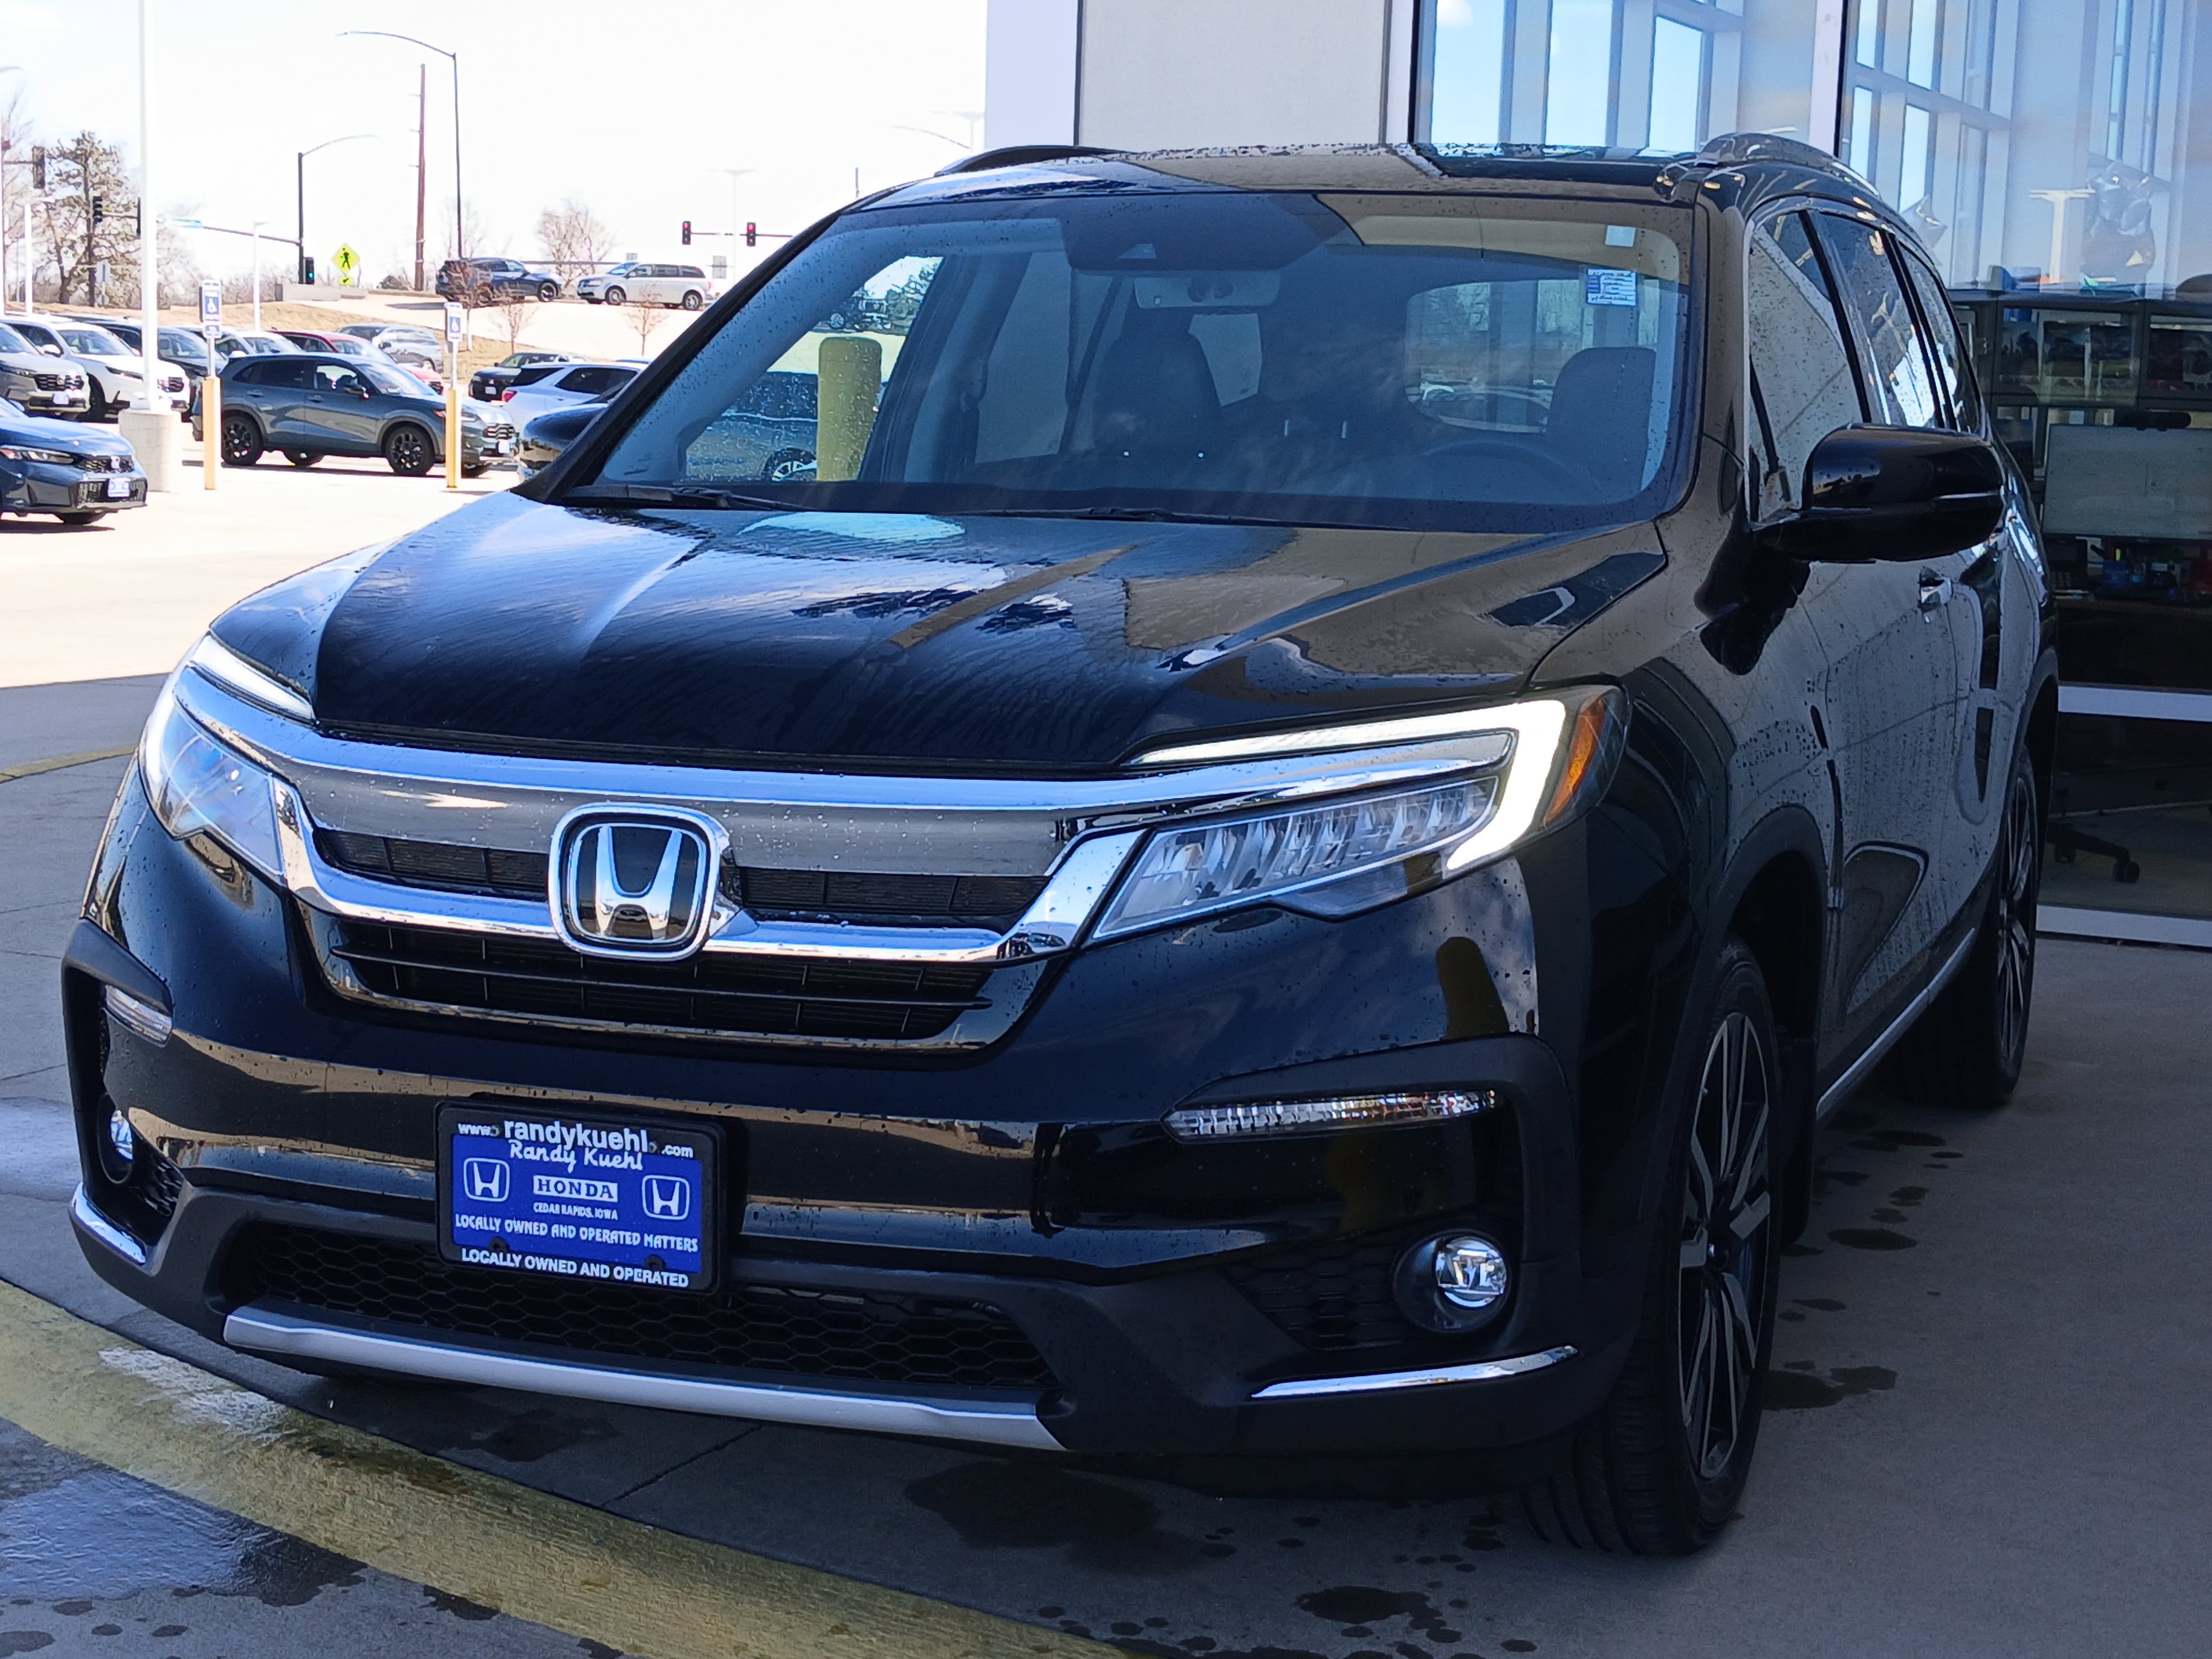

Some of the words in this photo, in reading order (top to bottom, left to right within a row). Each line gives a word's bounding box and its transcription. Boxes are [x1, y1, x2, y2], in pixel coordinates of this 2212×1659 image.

[504, 1120, 648, 1153] randykuehl
[661, 1145, 693, 1158] .com
[508, 1139, 577, 1173] Randy
[584, 1147, 643, 1171] Kuehl
[537, 1178, 614, 1199] HONDA
[455, 1213, 501, 1232] LOCALLY
[504, 1219, 548, 1236] OWNED
[551, 1224, 576, 1238] AND
[579, 1227, 641, 1245] OPERATED
[644, 1233, 698, 1252] MATTERS
[462, 1249, 522, 1268] LOCALLY
[524, 1255, 577, 1275] OWNED
[580, 1262, 610, 1278] AND
[613, 1266, 689, 1288] OPERATED
